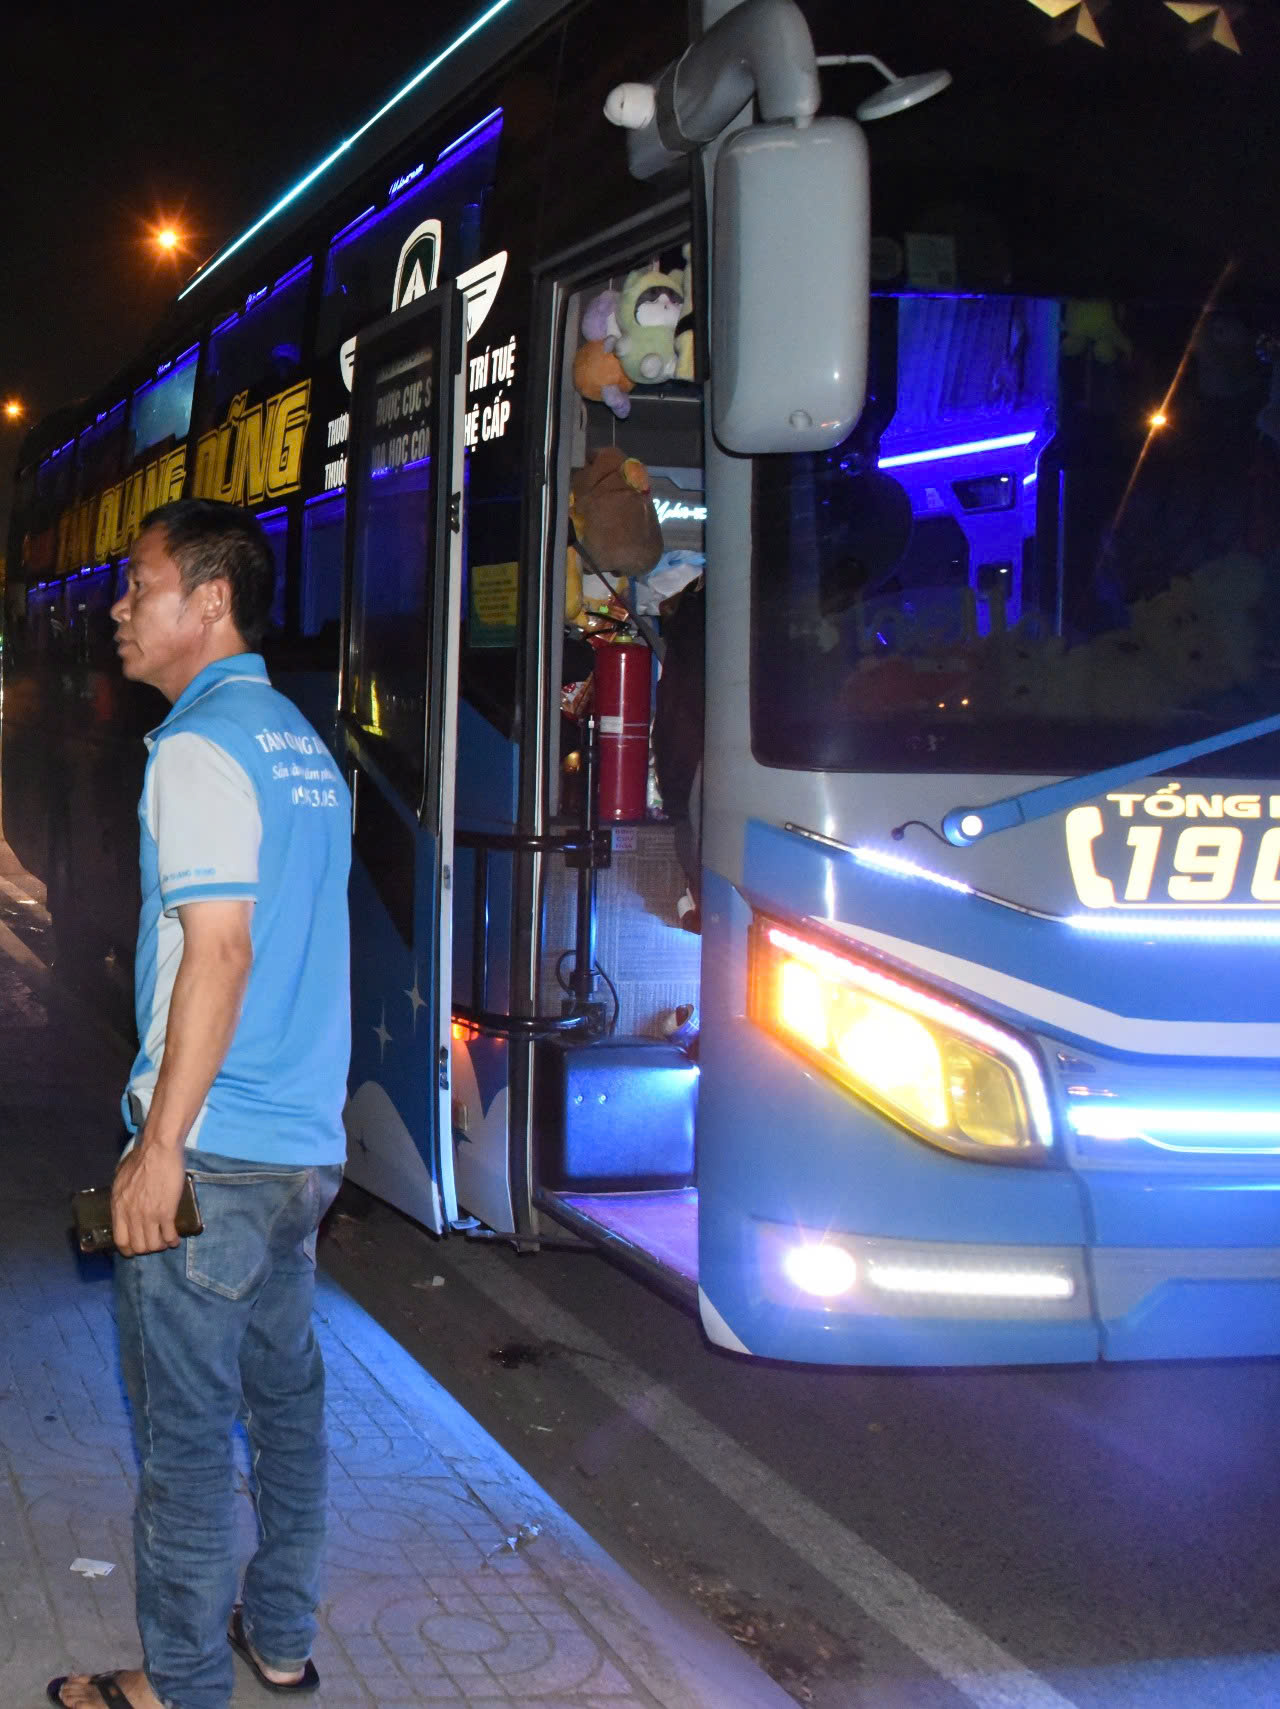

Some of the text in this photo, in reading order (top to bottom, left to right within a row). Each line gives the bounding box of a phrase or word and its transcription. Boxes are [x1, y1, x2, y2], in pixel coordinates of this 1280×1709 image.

[402, 380, 423, 421] CỤC
[469, 345, 490, 392] TRÍ
[492, 335, 516, 386] TUỆ
[482, 389, 511, 442] CẤP
[95, 444, 187, 565] QUANG
[192, 378, 312, 507] DŨNG
[1106, 782, 1262, 819] TỔNG
